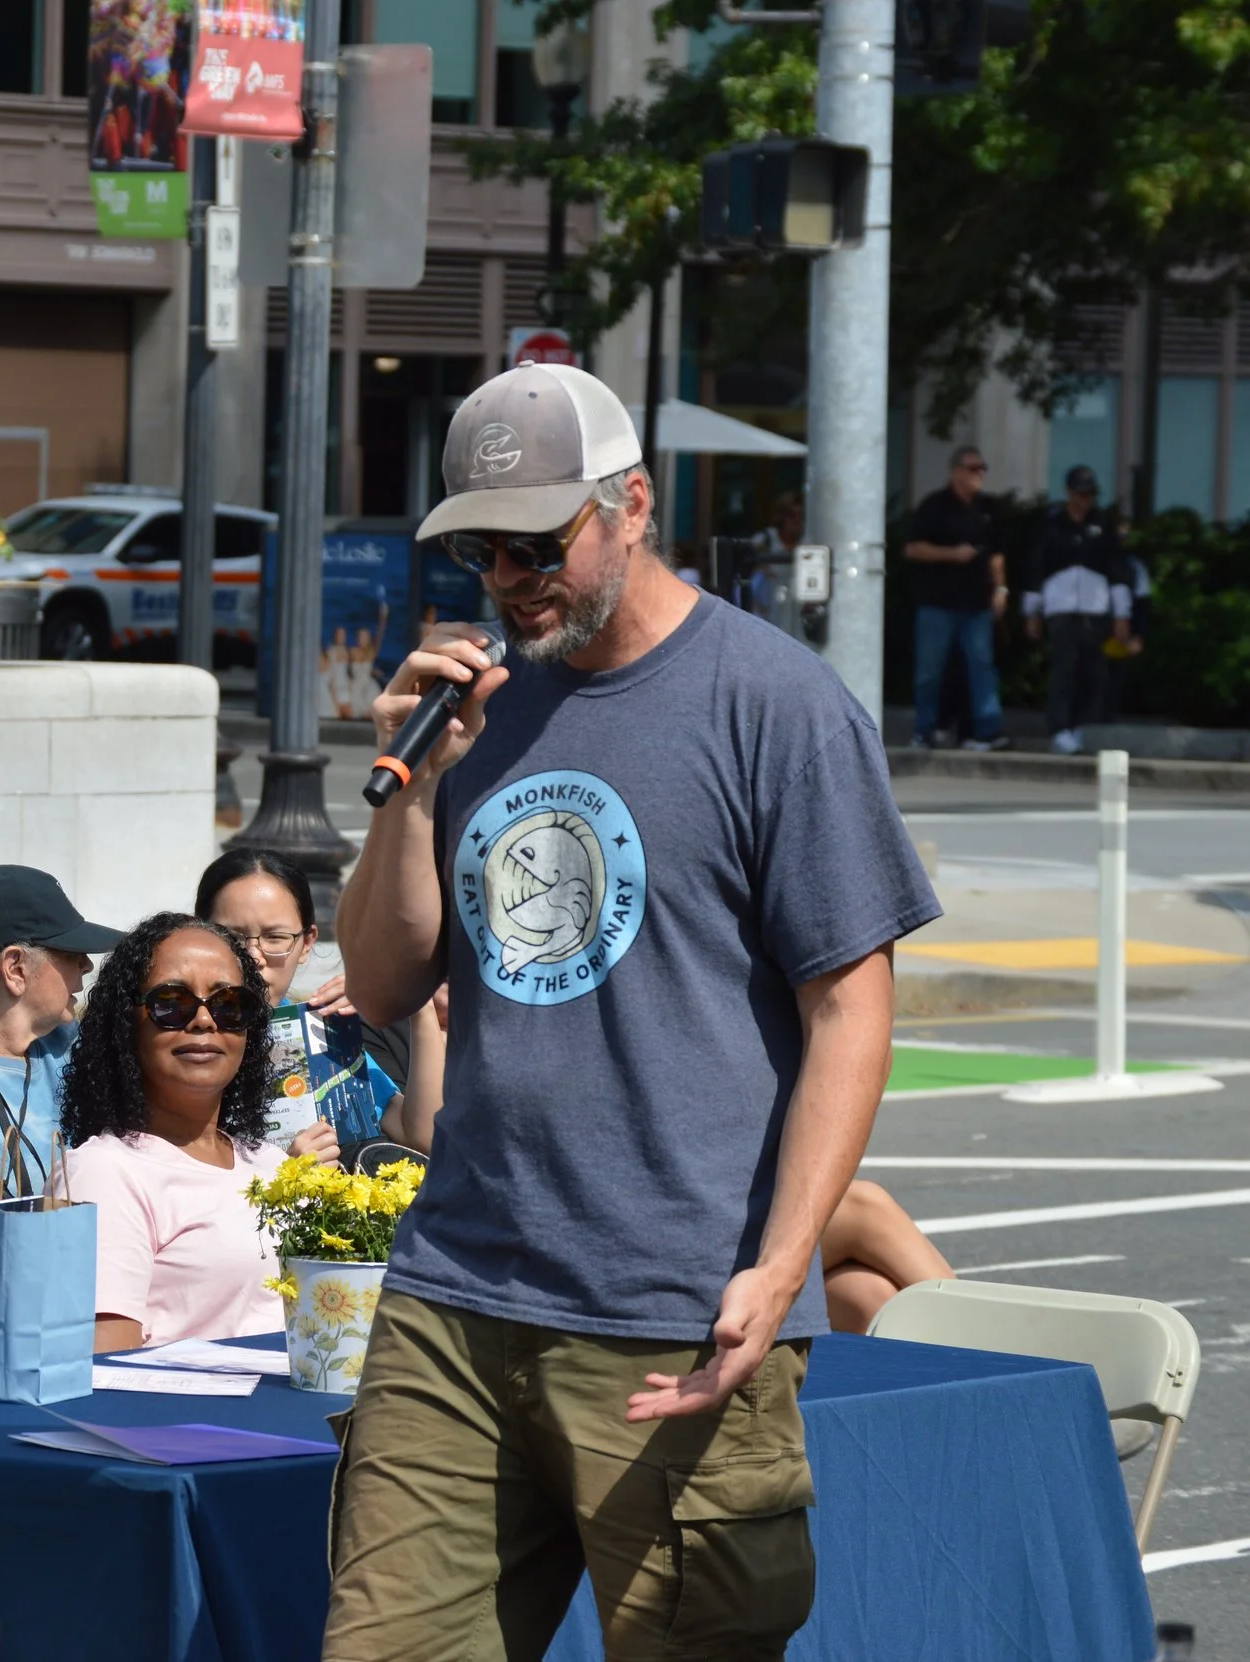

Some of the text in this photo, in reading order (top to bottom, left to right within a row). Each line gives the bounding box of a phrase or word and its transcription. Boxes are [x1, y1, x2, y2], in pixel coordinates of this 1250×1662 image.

[505, 784, 607, 815] MONKFISH
[462, 873, 481, 917] EAT
[497, 966, 526, 986] OF
[534, 975, 570, 993] THE
[576, 878, 633, 980] ORDINARY
